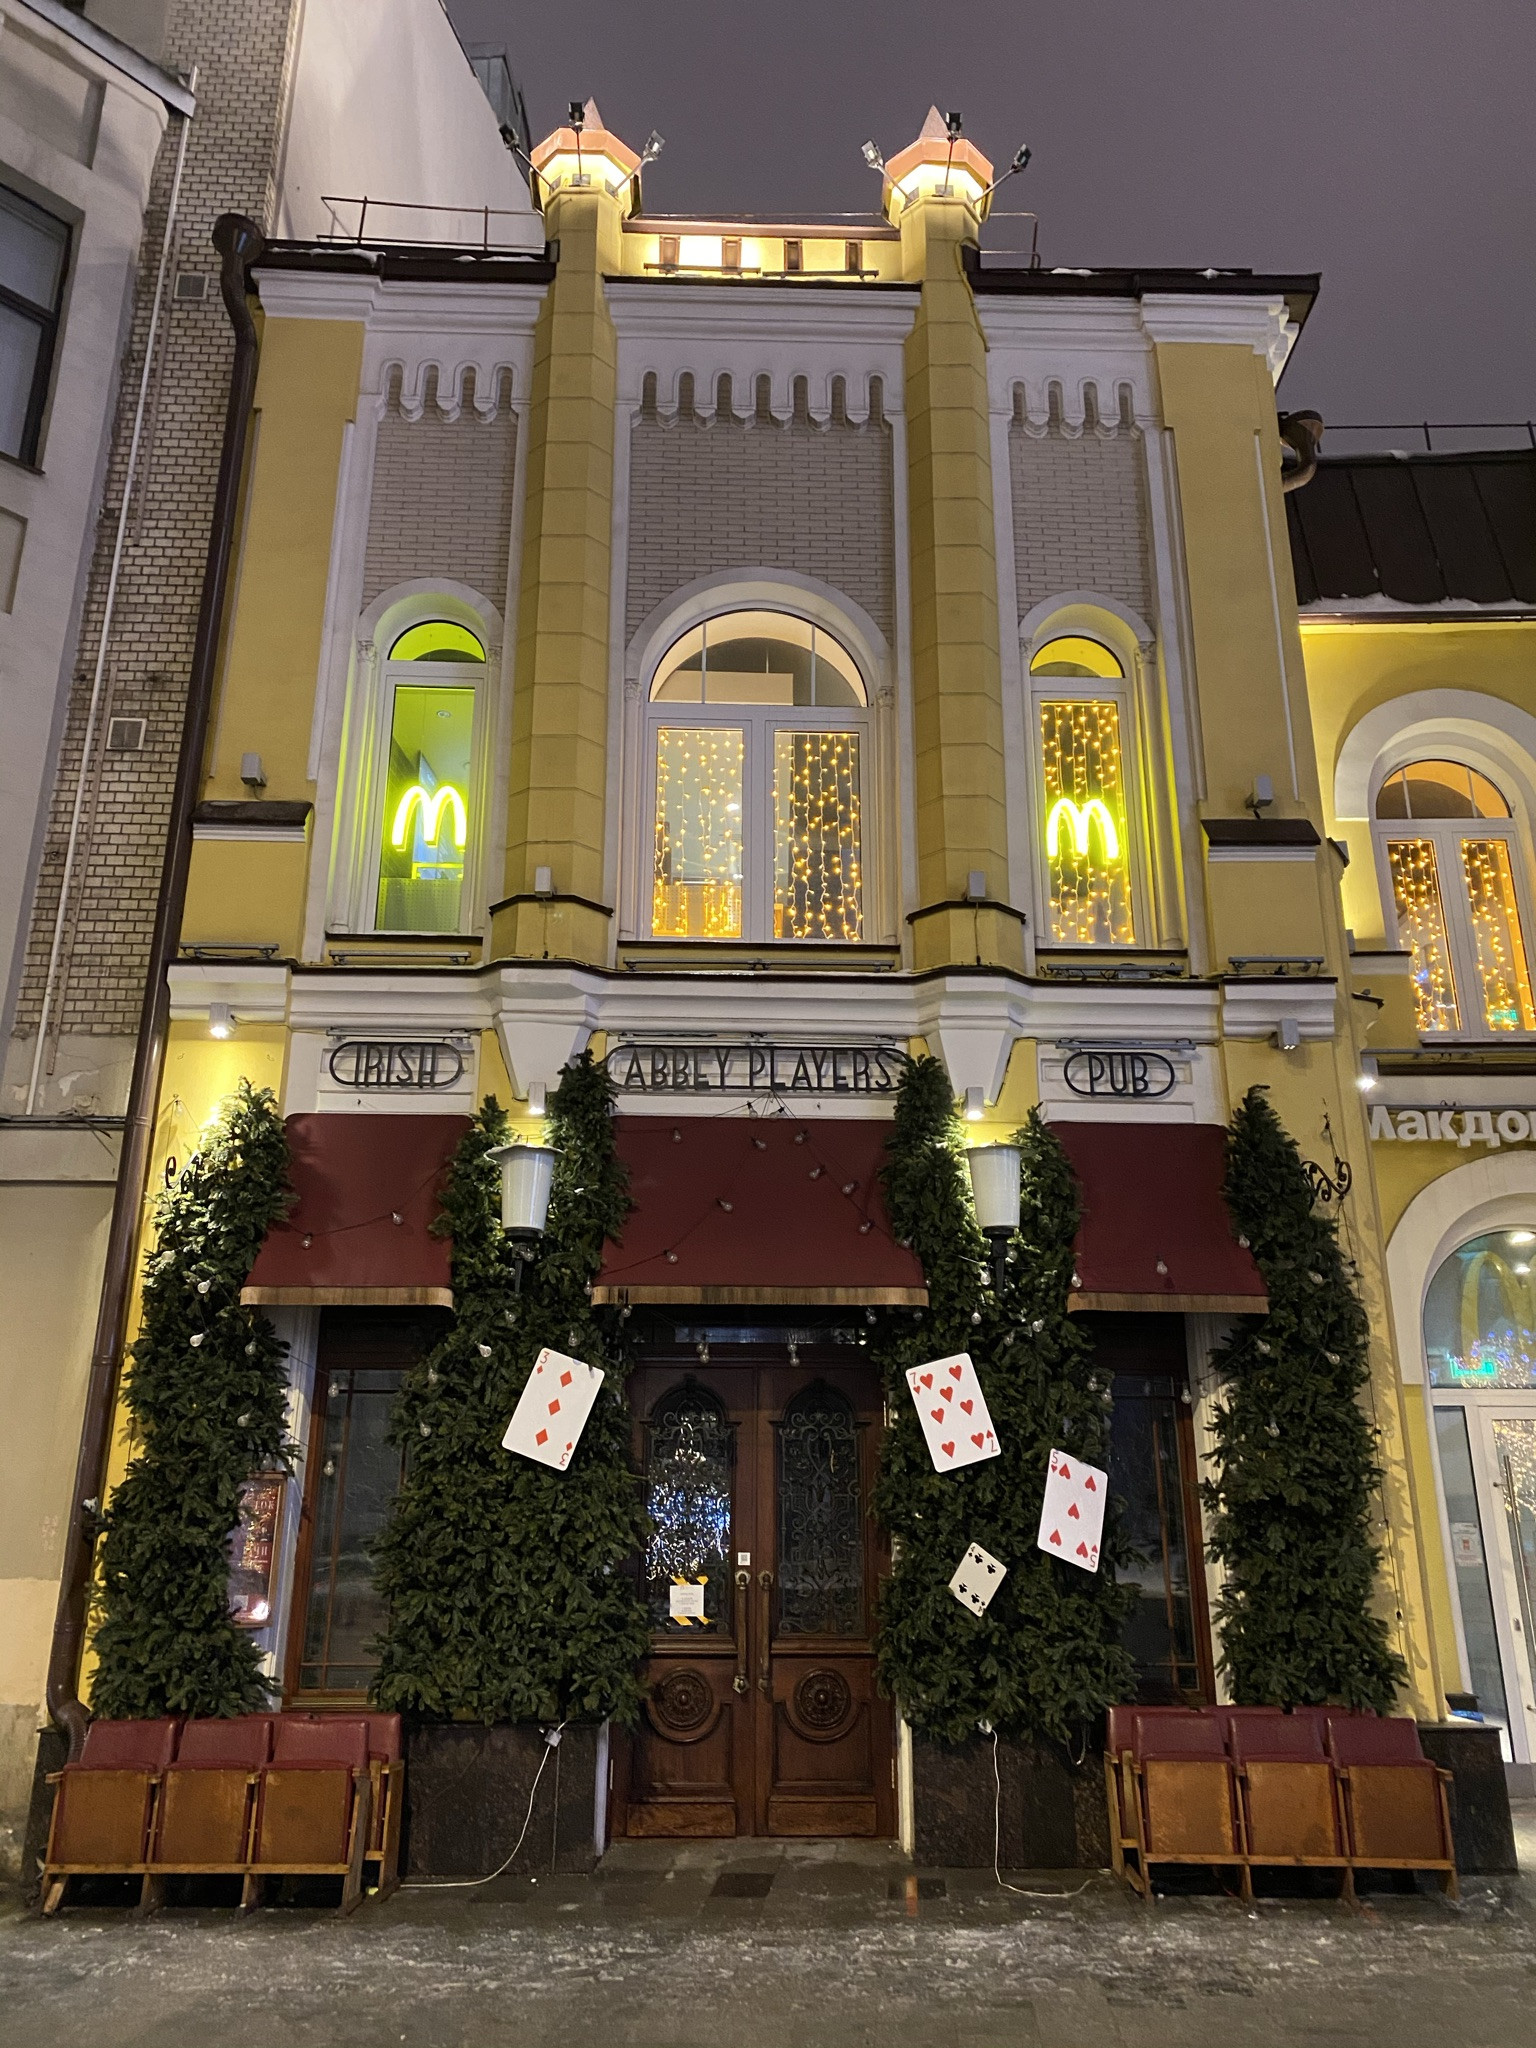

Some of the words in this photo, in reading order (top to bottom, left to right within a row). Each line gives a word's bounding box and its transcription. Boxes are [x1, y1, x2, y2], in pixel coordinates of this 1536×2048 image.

[353, 1043, 436, 1088] IRISH
[623, 1048, 731, 1091] ABBEY
[749, 1050, 892, 1093] PLAYERS
[1087, 1052, 1149, 1097] PUB
[1368, 1104, 1536, 1148] Макдо
[540, 1351, 550, 1364] 3
[909, 1371, 917, 1384] 7
